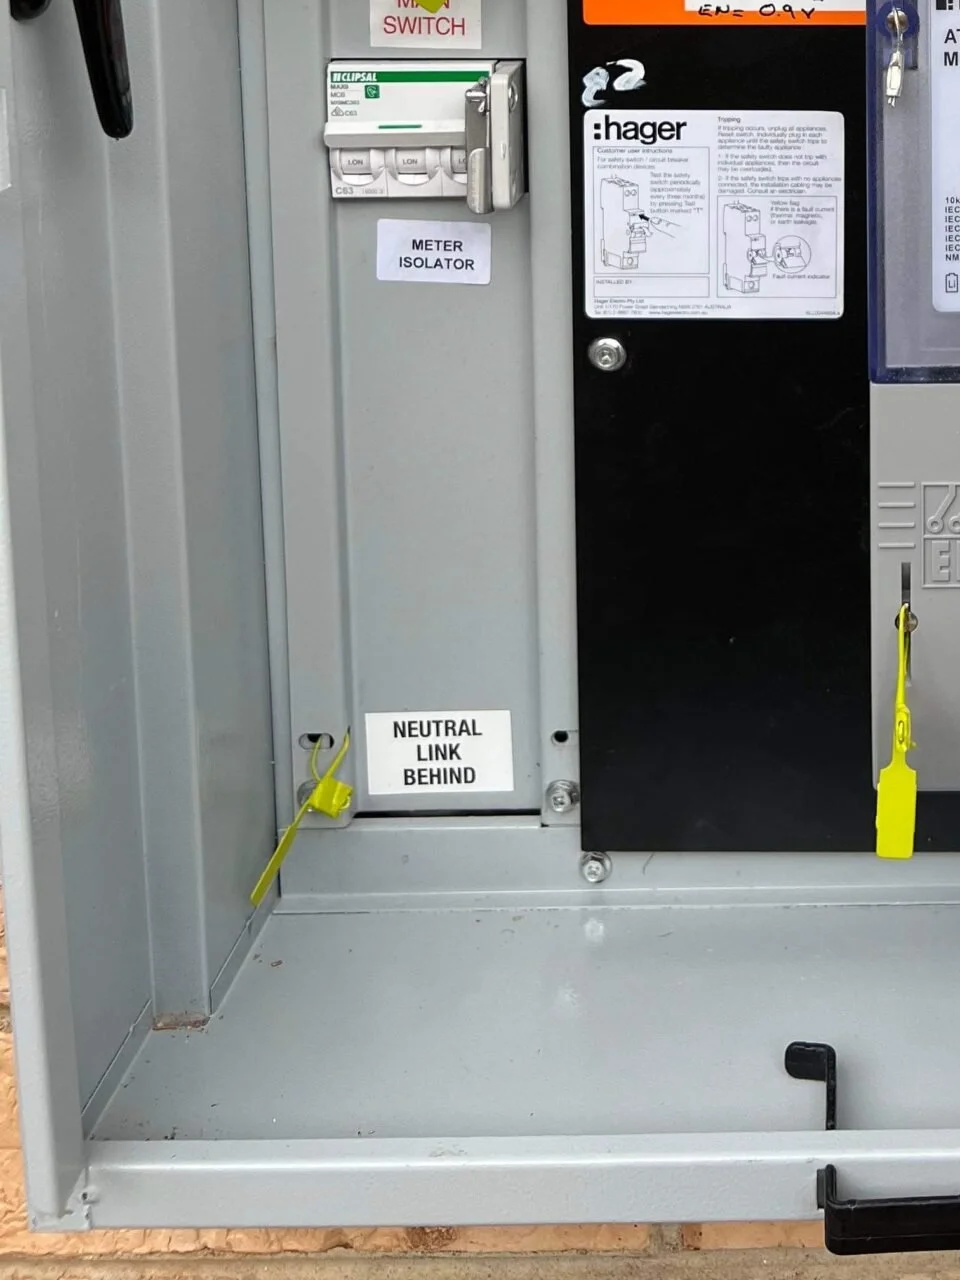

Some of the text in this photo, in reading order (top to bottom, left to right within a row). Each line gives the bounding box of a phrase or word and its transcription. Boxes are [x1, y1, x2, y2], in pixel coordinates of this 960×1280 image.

[383, 16, 466, 35] SWITCH
[342, 72, 377, 82] CLIPSAL
[411, 238, 463, 252] METER
[399, 256, 475, 271] ISOLATOR
[393, 718, 483, 738] NEUTRAL
[417, 743, 462, 761] LINK
[404, 767, 476, 785] BEHIND
